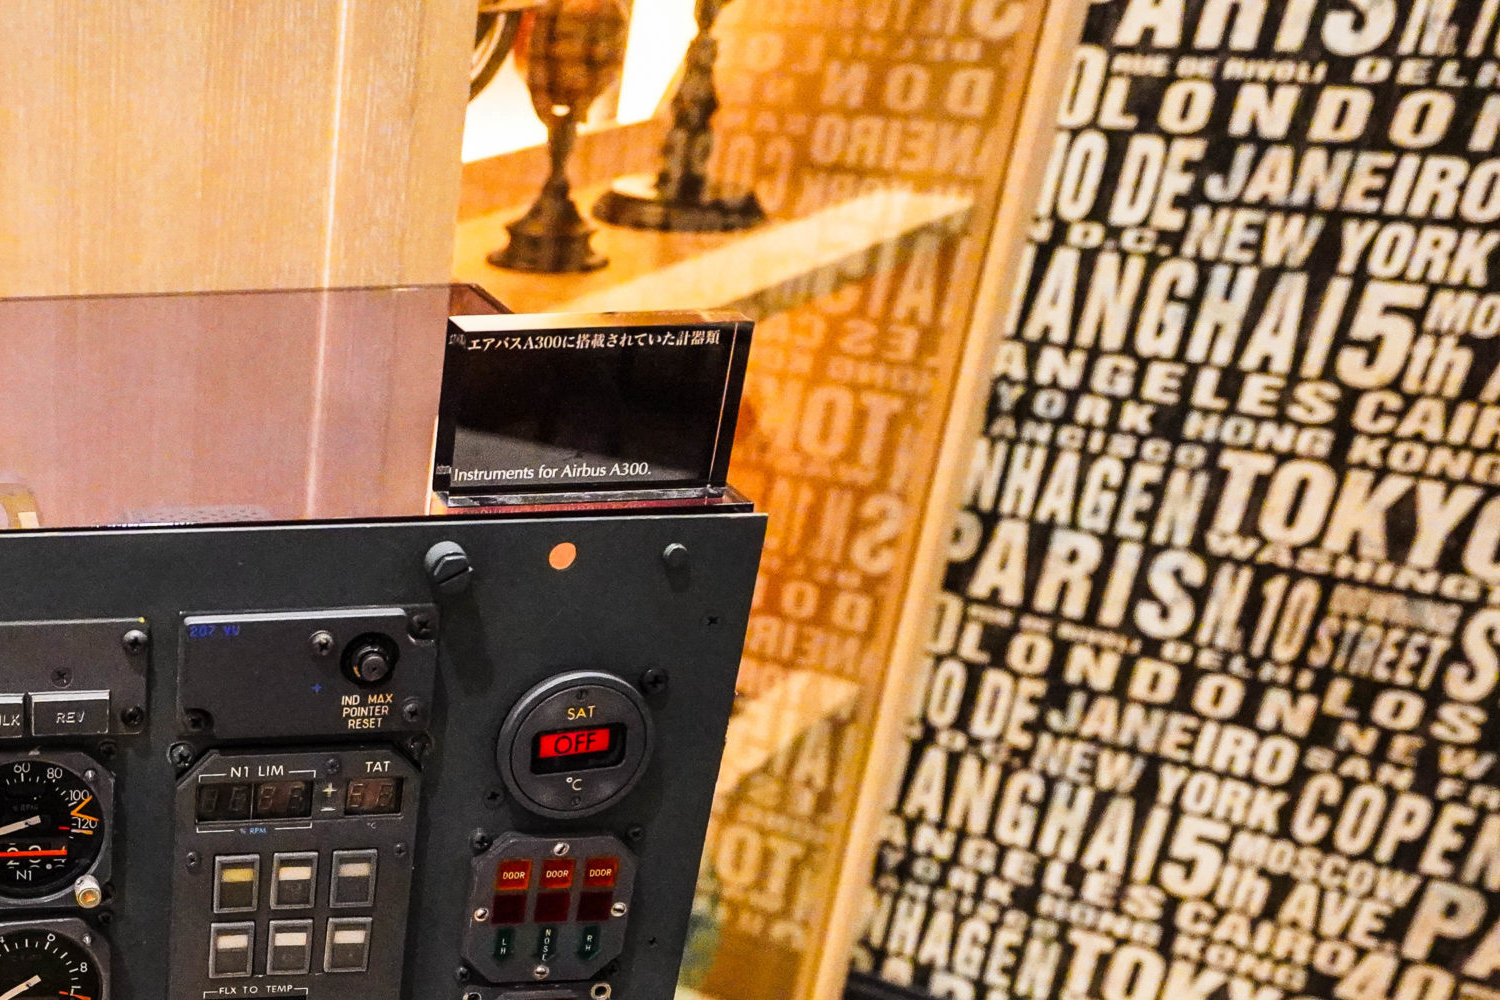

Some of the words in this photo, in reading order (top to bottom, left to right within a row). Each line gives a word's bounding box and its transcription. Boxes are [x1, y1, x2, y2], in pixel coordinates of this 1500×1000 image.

[1108, 133, 1207, 232] DE
[1203, 143, 1500, 224] JANEIRO
[1182, 203, 1326, 268] NEW
[1335, 216, 1500, 287] YORK
[467, 329, 721, 352] エアバスA300に搭載されていた計器類
[992, 340, 1342, 425] ANGELES
[1180, 409, 1336, 459] HONG
[453, 466, 534, 482] Instruments
[538, 464, 557, 479] for
[561, 463, 607, 478] Airbus
[610, 462, 652, 477] A300.
[958, 620, 1319, 739] LONDON
[341, 695, 360, 705] IND
[367, 693, 393, 704] MAX
[56, 711, 86, 724] REV
[342, 706, 389, 717] POINTER
[567, 705, 596, 720] SAT
[348, 717, 383, 729] RESET
[969, 667, 1049, 749] DE
[1045, 690, 1300, 787] JANEIRO
[554, 731, 597, 755] OFF
[230, 766, 249, 778] N1
[258, 765, 284, 777] LIM
[365, 761, 391, 773] TAT
[1030, 734, 1147, 794] NEW
[1159, 763, 1294, 834] YORK
[16, 868, 33, 881] N1
[502, 871, 526, 880] DOOR
[546, 869, 569, 879] DOOR
[589, 867, 612, 877] DOOR
[1230, 829, 1422, 907] MOSCOW
[218, 986, 237, 995] FLX
[243, 986, 258, 994] TO
[266, 984, 293, 993] TEMP
